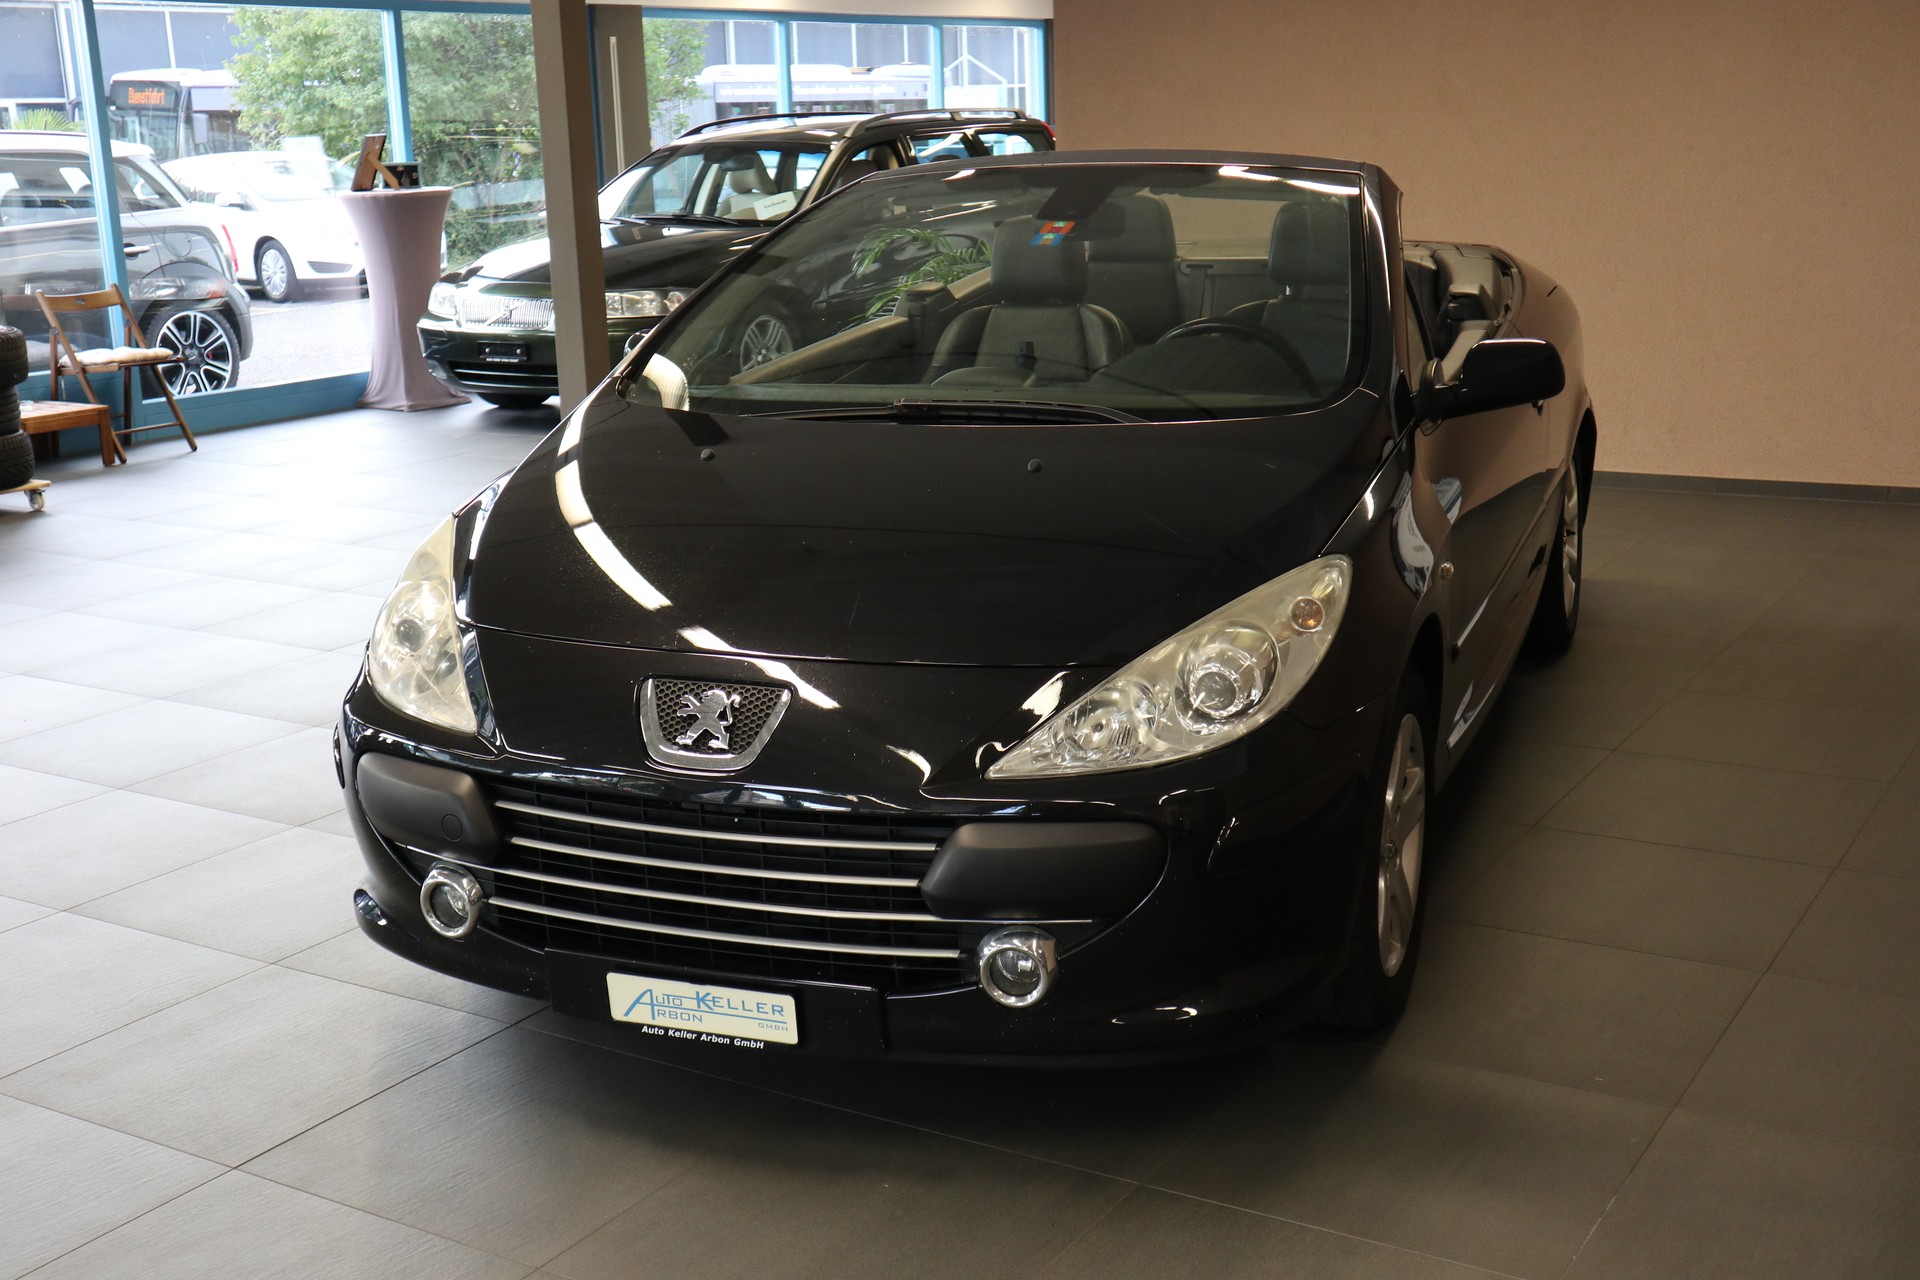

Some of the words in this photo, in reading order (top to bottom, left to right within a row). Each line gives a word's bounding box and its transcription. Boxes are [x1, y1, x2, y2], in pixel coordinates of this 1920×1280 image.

[696, 991, 785, 1017] KELLER
[641, 1025, 665, 1036] Auto
[668, 1029, 697, 1040] Keller
[700, 1034, 730, 1045] Arbon
[734, 1038, 764, 1050] GmbH
[757, 1022, 789, 1032] GMBH
